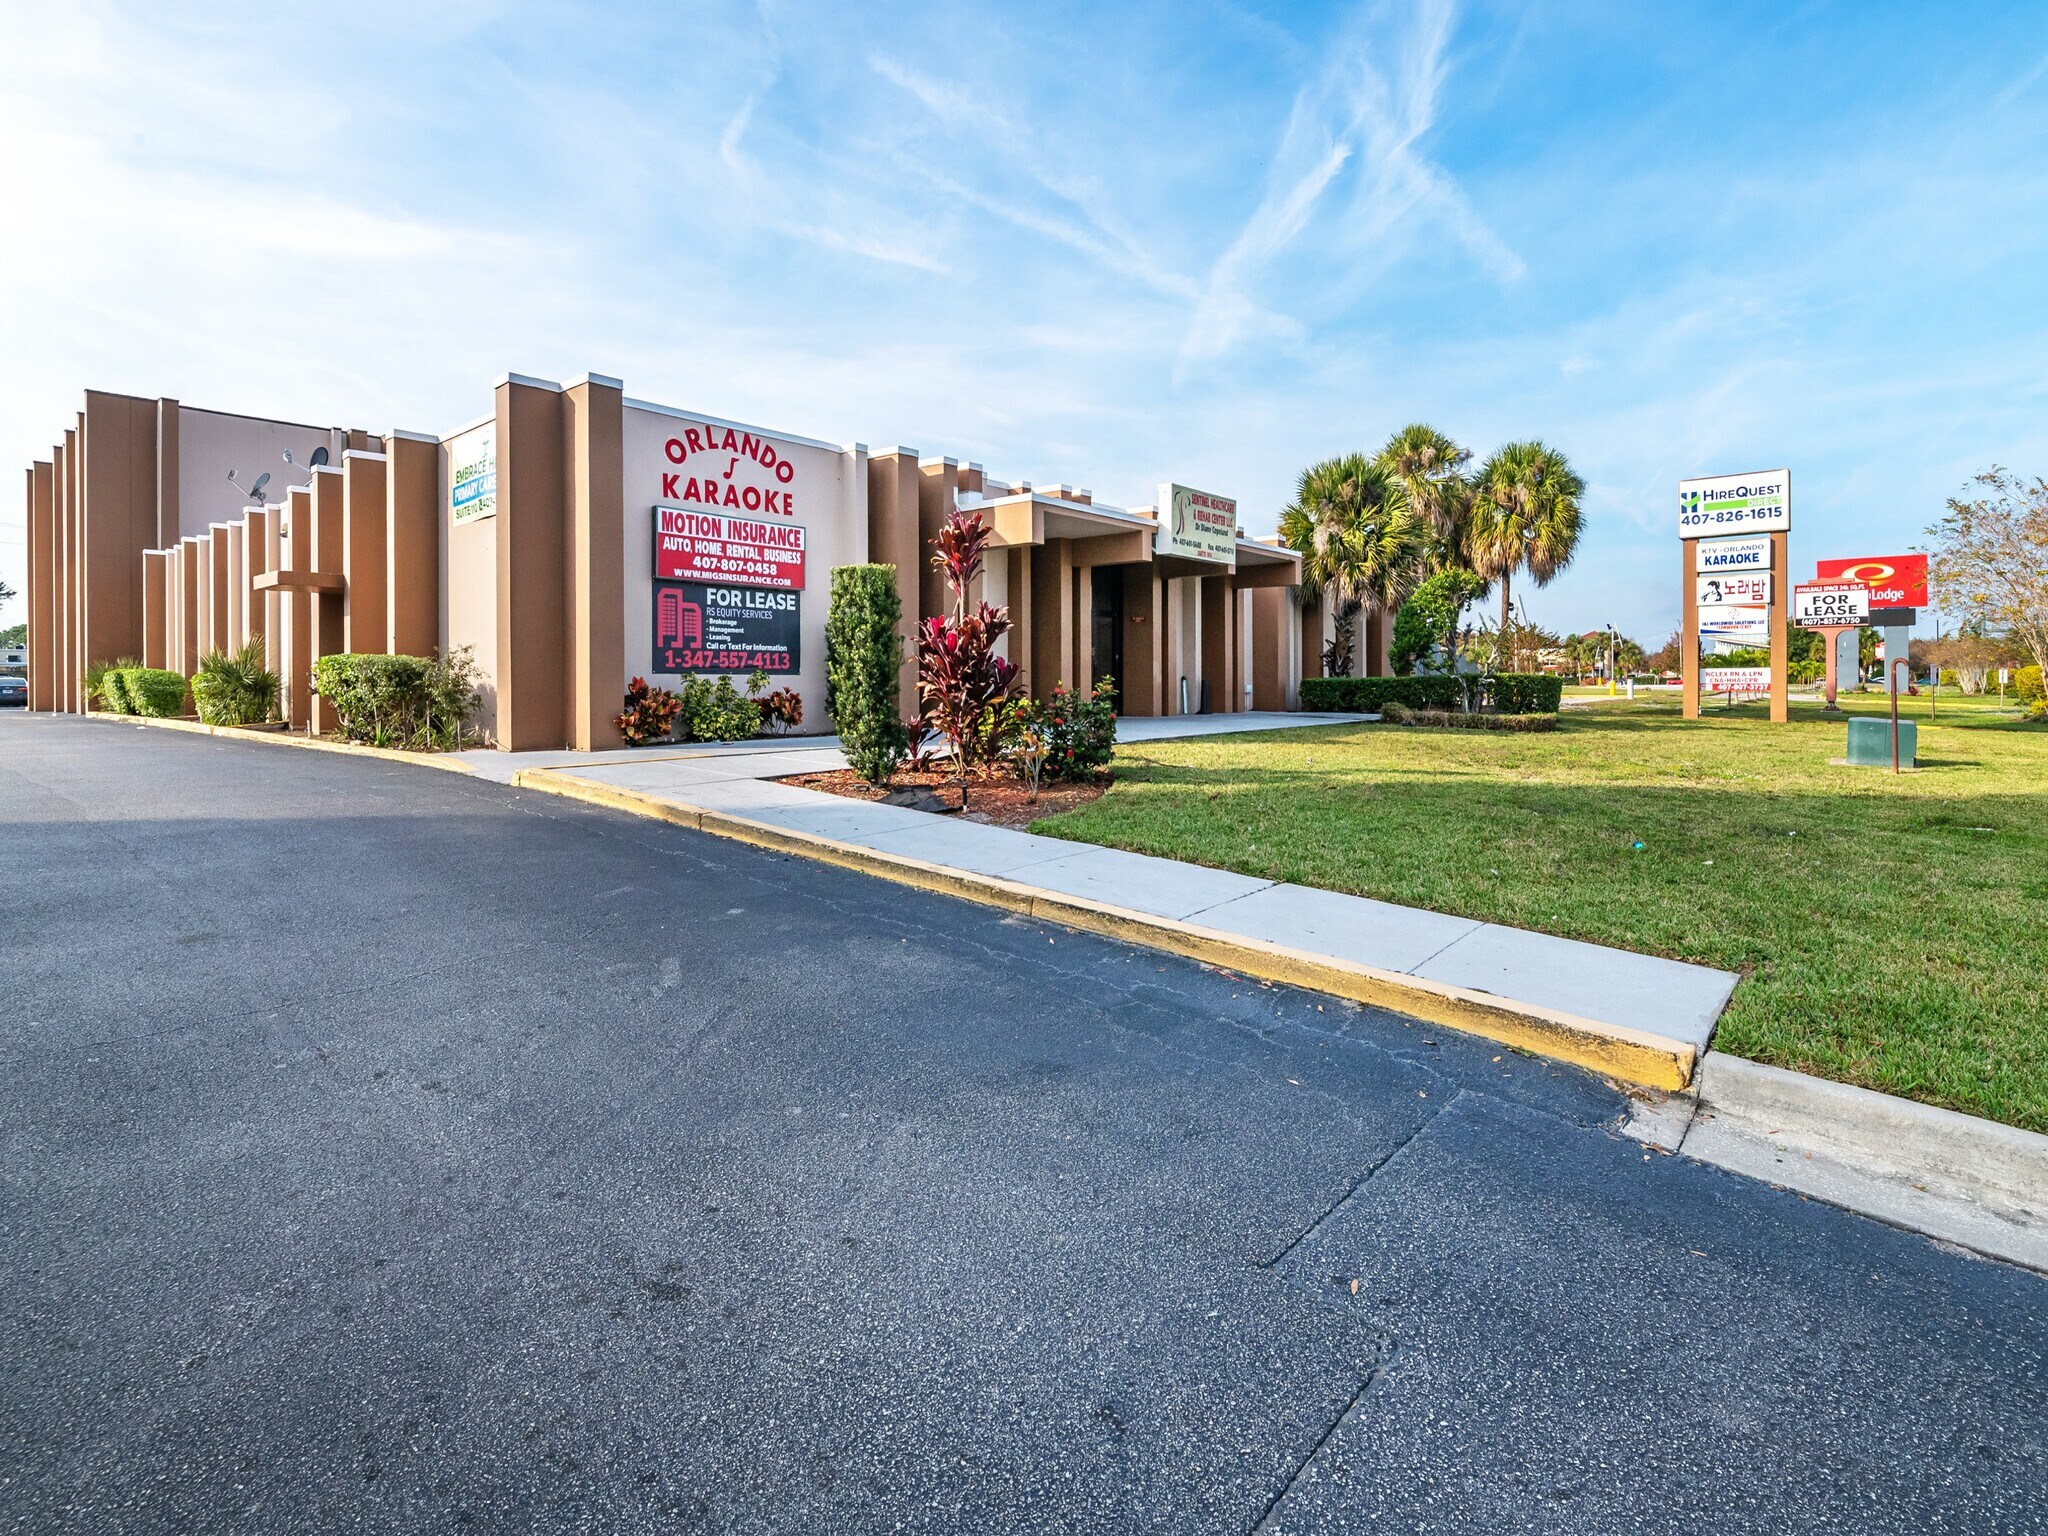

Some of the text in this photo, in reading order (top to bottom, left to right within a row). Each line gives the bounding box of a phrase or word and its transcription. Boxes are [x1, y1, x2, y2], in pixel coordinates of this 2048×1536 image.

[664, 425, 794, 483] ORLANDO
[456, 459, 487, 484] EMBRACE
[662, 473, 793, 516] KARAOKE
[1747, 496, 1782, 507] DIRECT
[1192, 494, 1235, 514] SENTINEL HEALTHCARE
[456, 505, 471, 519] SUITE
[1197, 510, 1211, 523] REHAB
[1211, 513, 1225, 526] CENTER
[1681, 507, 1782, 526] 407-826-1615
[661, 510, 801, 549] MOTION INSURANCE
[663, 536, 801, 565] AUTO, HOME, RENTAL, BUSINESS
[1723, 544, 1764, 553] ORLANDO
[692, 556, 777, 575] 407-807-0458
[1704, 552, 1760, 566] KARAOKE
[674, 568, 791, 586] WWW.MIGSINSURANCE.COM
[706, 587, 796, 611] FOR LEASE
[1812, 594, 1849, 605] FOR
[1871, 588, 1905, 603] Lodge
[706, 607, 773, 620] RS EQUITY SERVICES
[1804, 605, 1858, 616] LEASE
[709, 618, 737, 626] Brokerage
[709, 626, 744, 634] Management
[709, 634, 731, 642] Leasing
[706, 642, 718, 650] Call
[742, 643, 752, 651] For
[753, 644, 788, 652] Information
[665, 650, 790, 670] 1-347-557-4113
